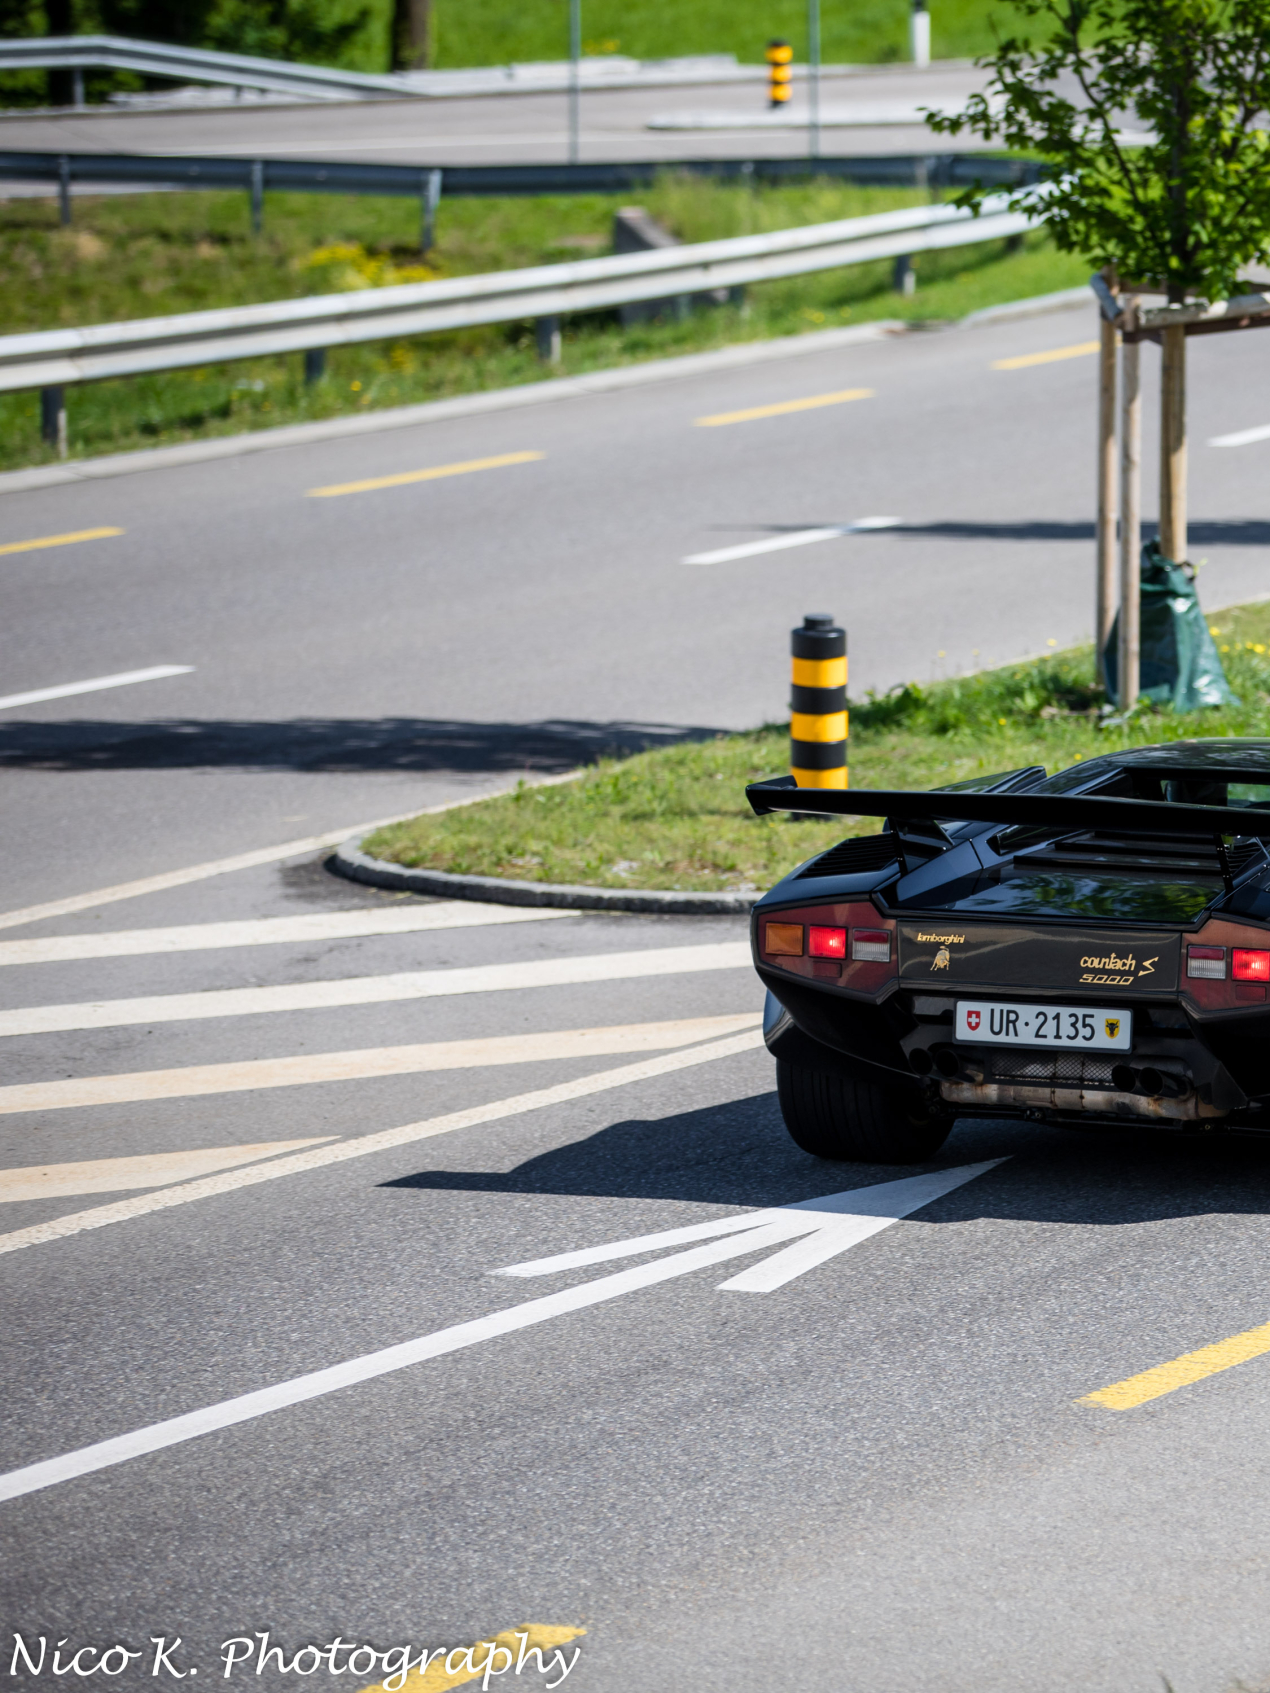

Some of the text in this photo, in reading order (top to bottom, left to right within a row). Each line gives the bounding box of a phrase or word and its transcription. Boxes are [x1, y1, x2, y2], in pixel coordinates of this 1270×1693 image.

[917, 932, 965, 945] lamborghini
[1080, 952, 1136, 971] countach
[1079, 973, 1134, 986] 5000
